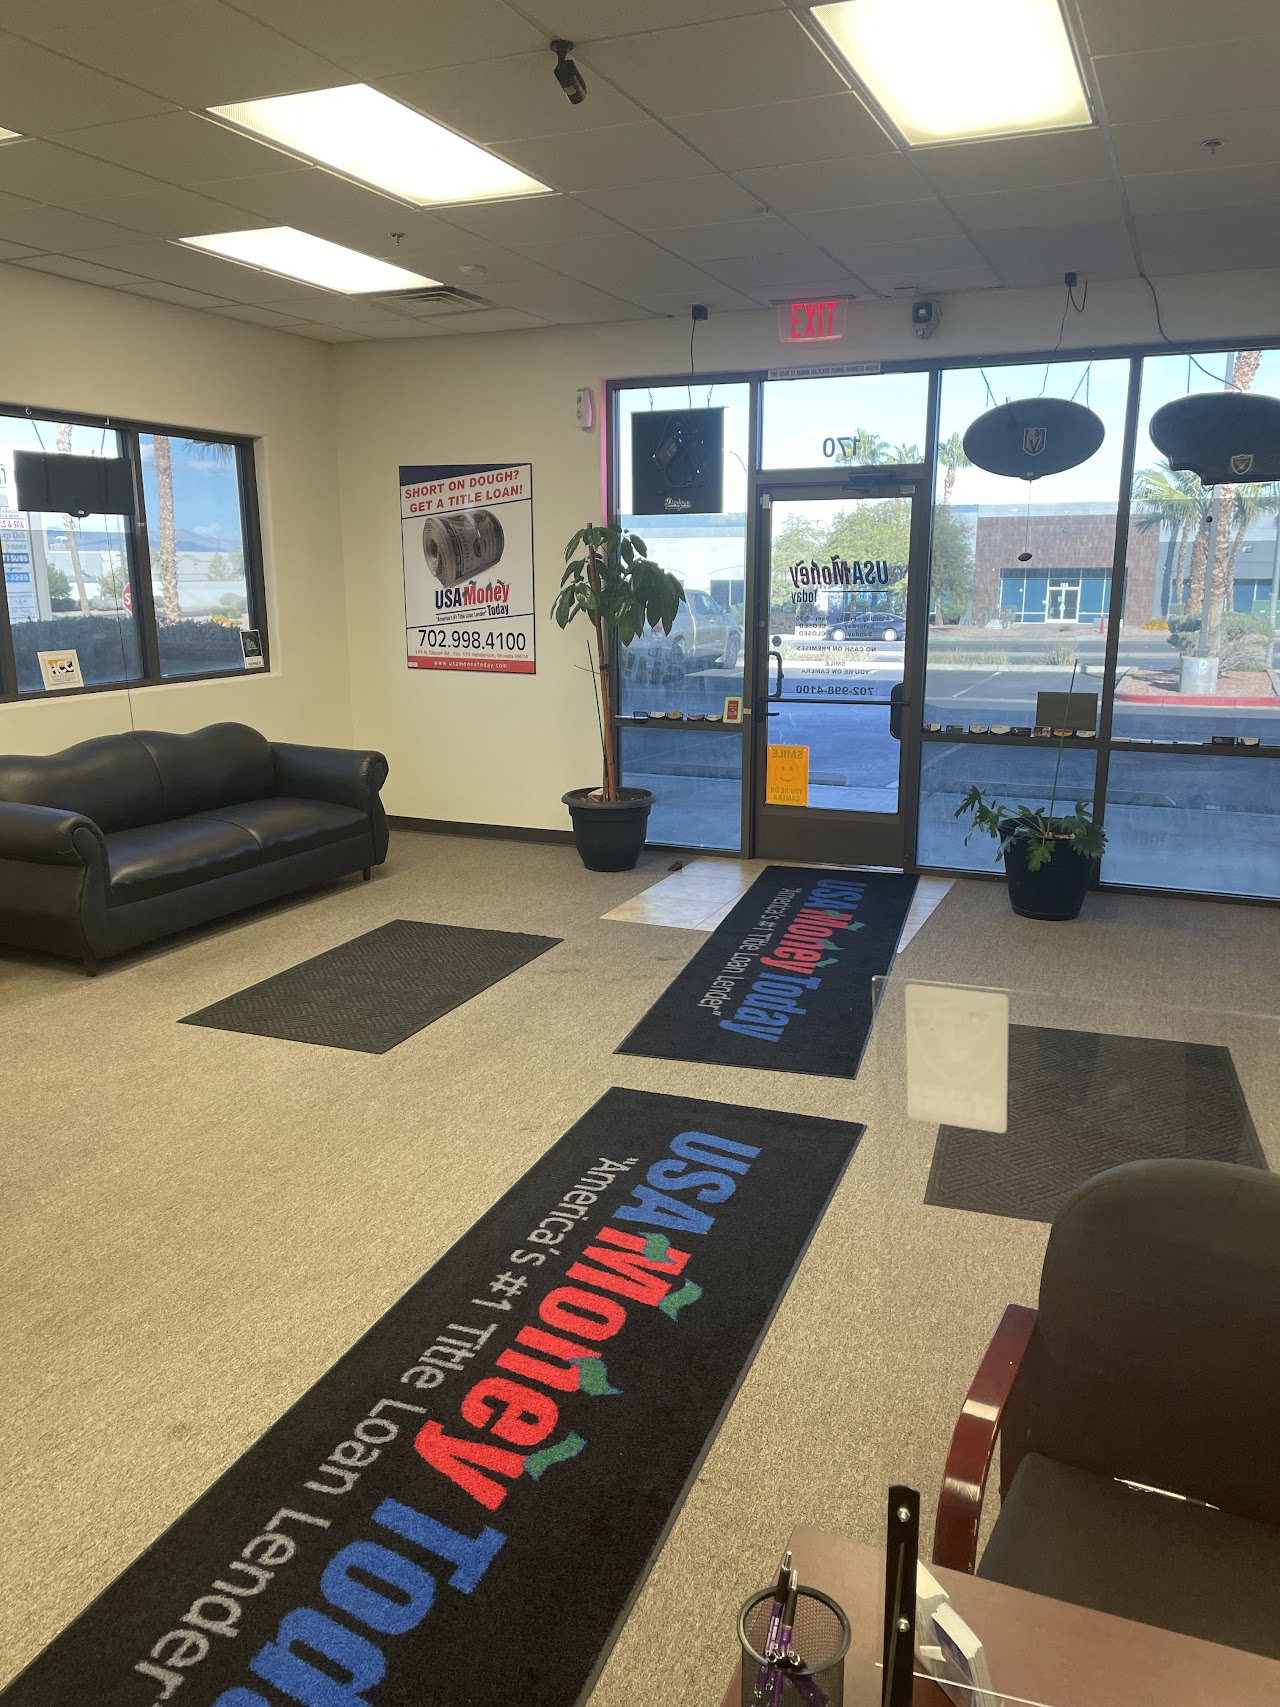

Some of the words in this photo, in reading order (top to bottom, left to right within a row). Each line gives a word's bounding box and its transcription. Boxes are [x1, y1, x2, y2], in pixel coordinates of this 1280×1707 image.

[791, 302, 838, 338] EXIT
[405, 483, 444, 499] SHORT
[448, 480, 465, 491] ON
[470, 470, 519, 488] DOUGH?
[410, 500, 432, 513] GET
[436, 499, 444, 509] A
[448, 492, 482, 507] TITLE
[486, 484, 523, 500] LOAN!
[435, 588, 462, 609] USA
[462, 582, 510, 605] Money
[487, 604, 509, 616] Today
[418, 629, 526, 650] 702.998.4100
[804, 879, 868, 910] USA
[739, 933, 772, 950] Title
[752, 920, 777, 931] #1
[760, 908, 854, 975] Money
[722, 952, 760, 973] Loan
[697, 976, 744, 1016] Lender"
[719, 972, 822, 1043] Today
[613, 1130, 762, 1236] USA
[472, 1271, 530, 1312] #1
[402, 1323, 498, 1391] Title
[413, 1226, 695, 1512] Money
[305, 1398, 426, 1496] Loan
[214, 1497, 507, 1707] Tod
